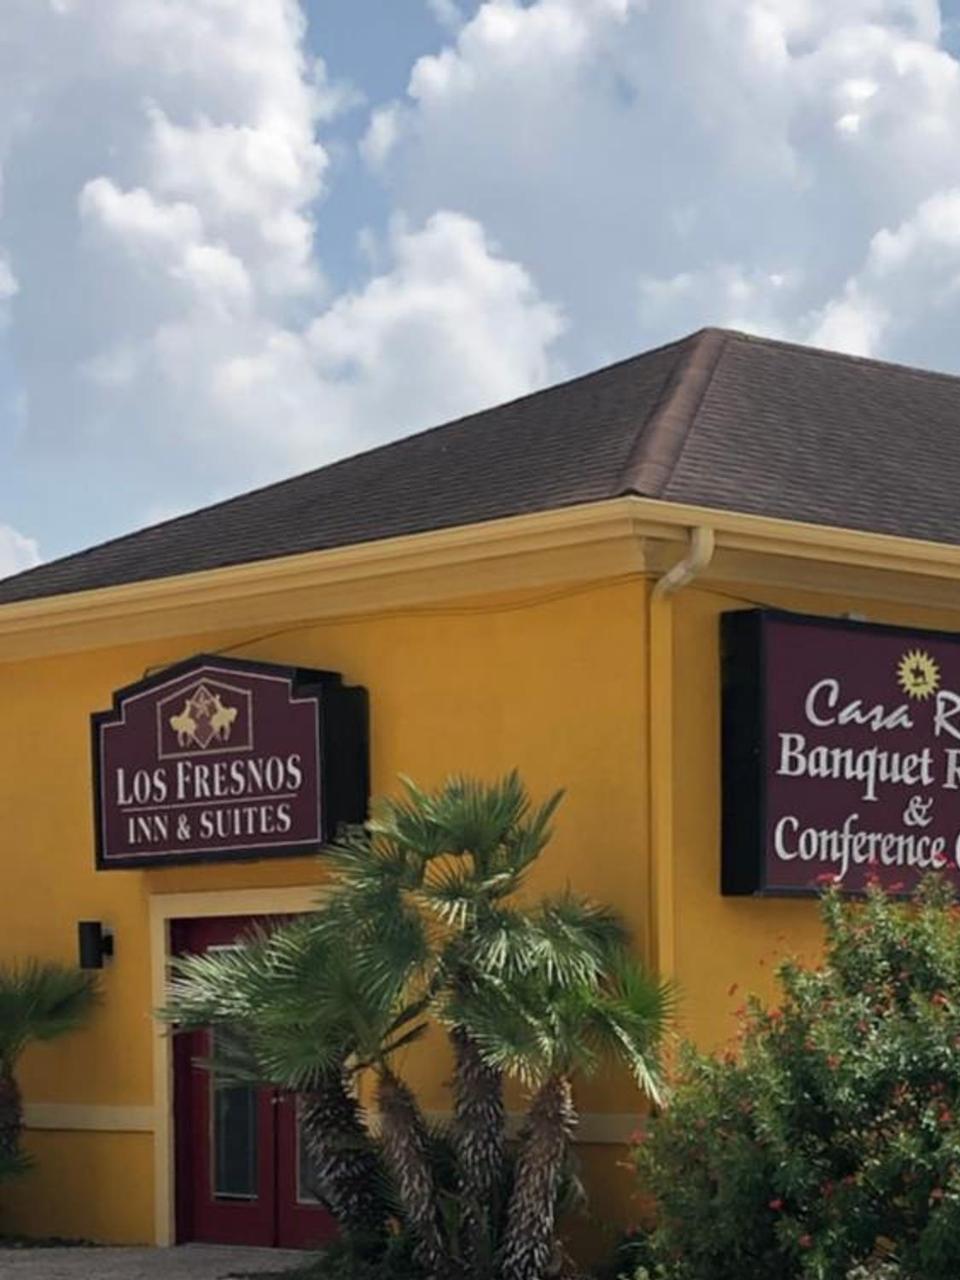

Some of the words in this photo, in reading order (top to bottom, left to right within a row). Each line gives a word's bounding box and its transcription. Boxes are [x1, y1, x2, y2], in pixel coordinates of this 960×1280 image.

[805, 678, 914, 732] Casa
[117, 768, 167, 805] LOS
[176, 754, 302, 800] FRESNOS
[776, 733, 935, 801] Banquet
[128, 815, 169, 844] INN
[176, 814, 191, 841] &
[200, 804, 292, 838] SUITES
[903, 796, 933, 827] &
[774, 814, 947, 881] Conference
